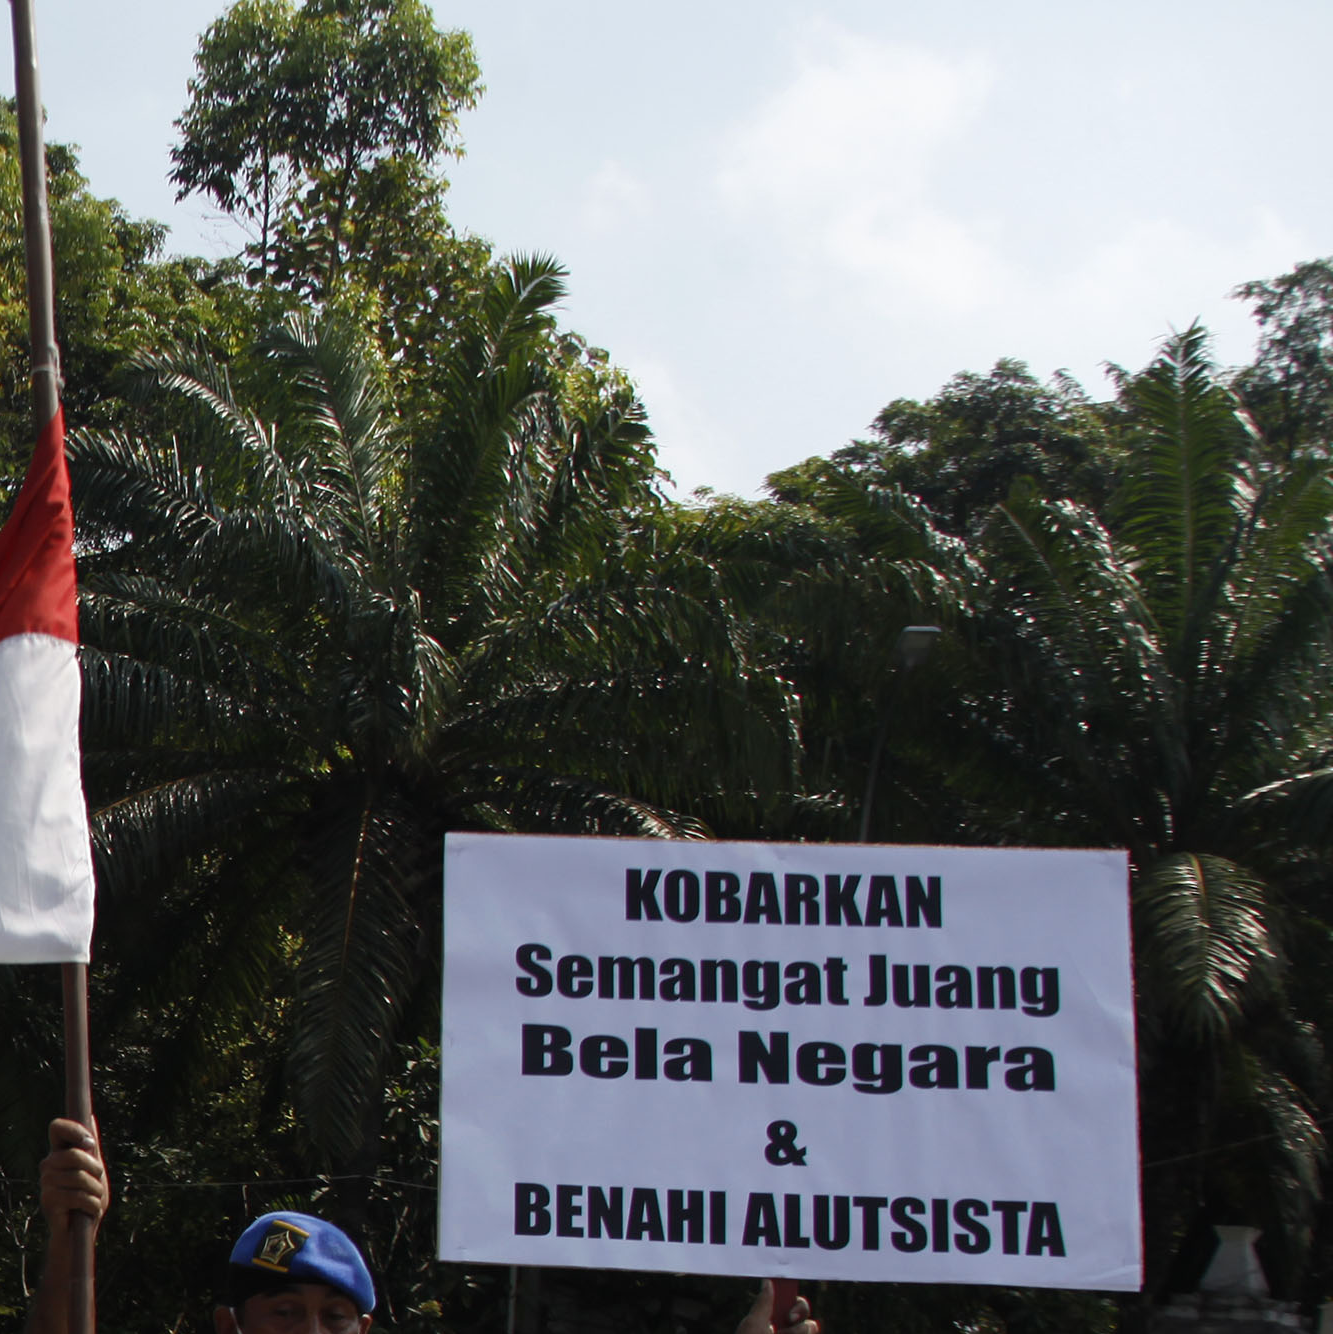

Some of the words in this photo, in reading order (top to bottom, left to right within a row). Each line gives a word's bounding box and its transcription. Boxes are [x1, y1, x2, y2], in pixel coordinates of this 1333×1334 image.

[624, 867, 943, 929] KOBARKAN
[514, 942, 848, 1011] Semangat
[863, 953, 1062, 1018] Juang
[520, 1023, 713, 1082] Bela
[737, 1030, 1056, 1095] Negara
[763, 1119, 808, 1167] &
[513, 1182, 727, 1246] BENAHI
[741, 1192, 1067, 1258] ALUTSISTA
